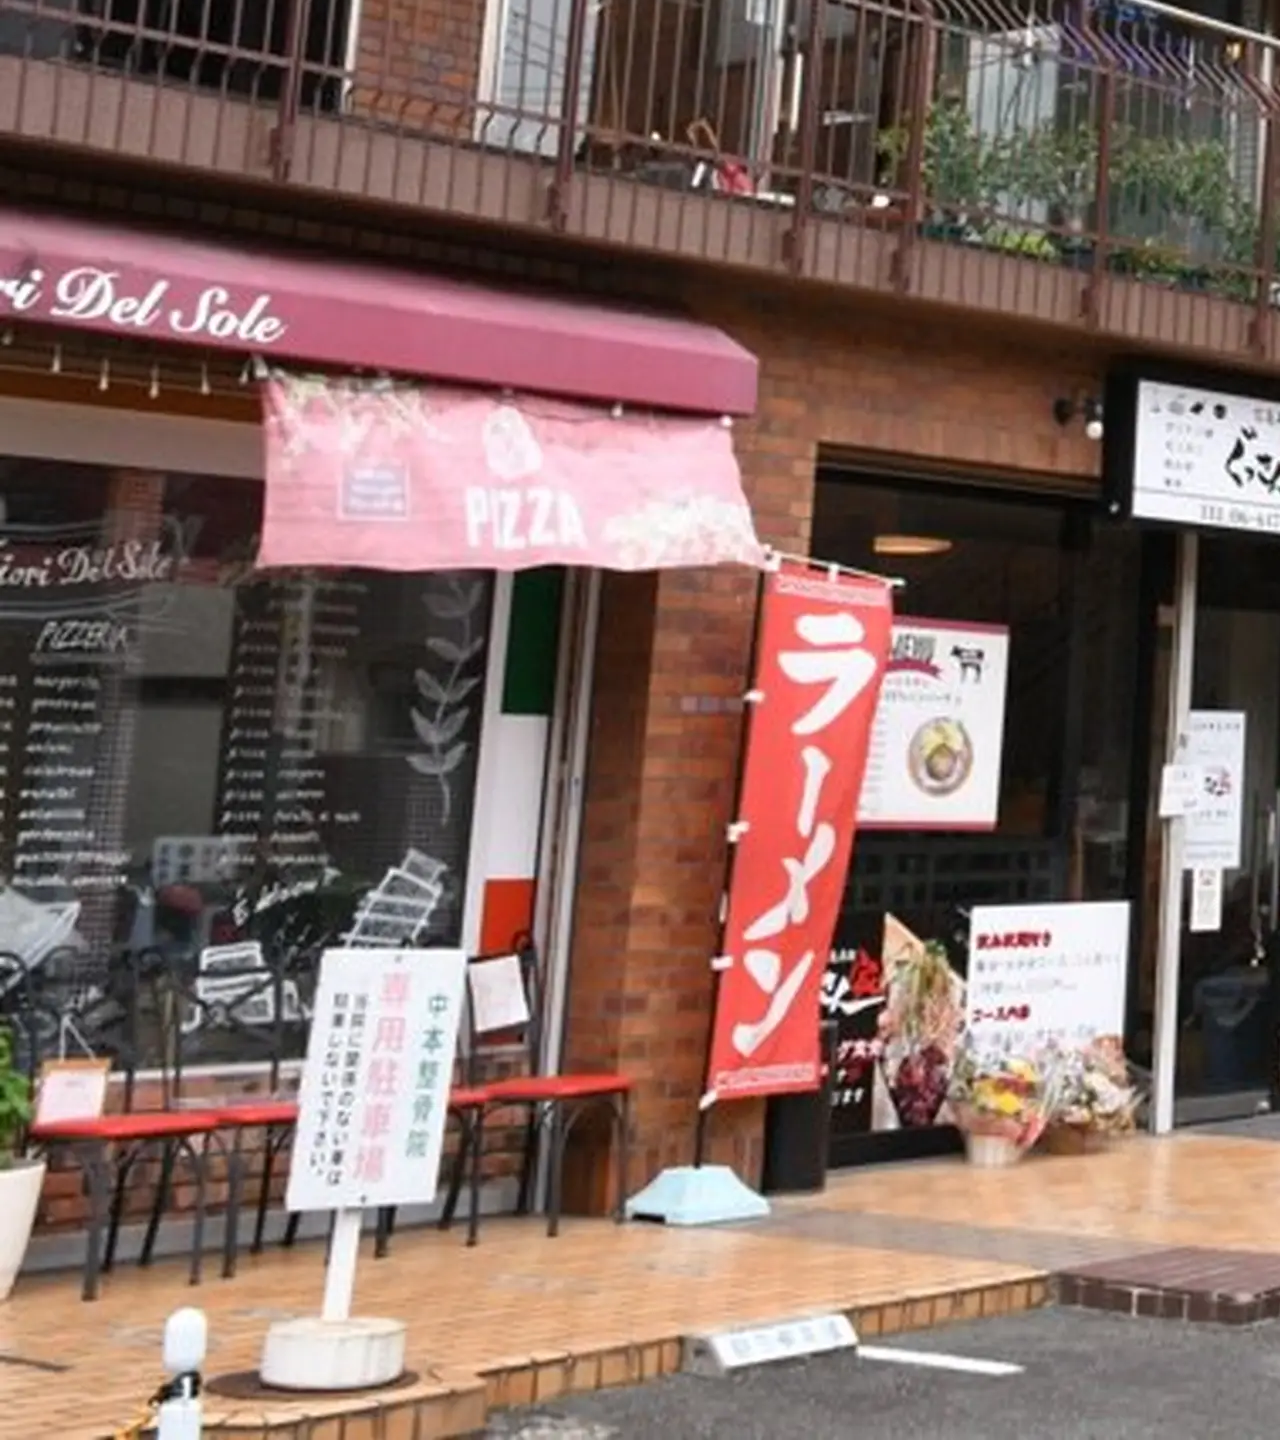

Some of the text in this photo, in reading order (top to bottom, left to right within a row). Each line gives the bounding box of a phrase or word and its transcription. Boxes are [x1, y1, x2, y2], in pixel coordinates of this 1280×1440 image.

[50, 266, 169, 326] Del
[169, 286, 289, 343] Sole
[465, 486, 589, 550] PIZZA
[731, 612, 878, 1058] ラーメン
[352, 971, 412, 1182] 専用駐車場
[405, 994, 450, 1158] 中本整骨院
